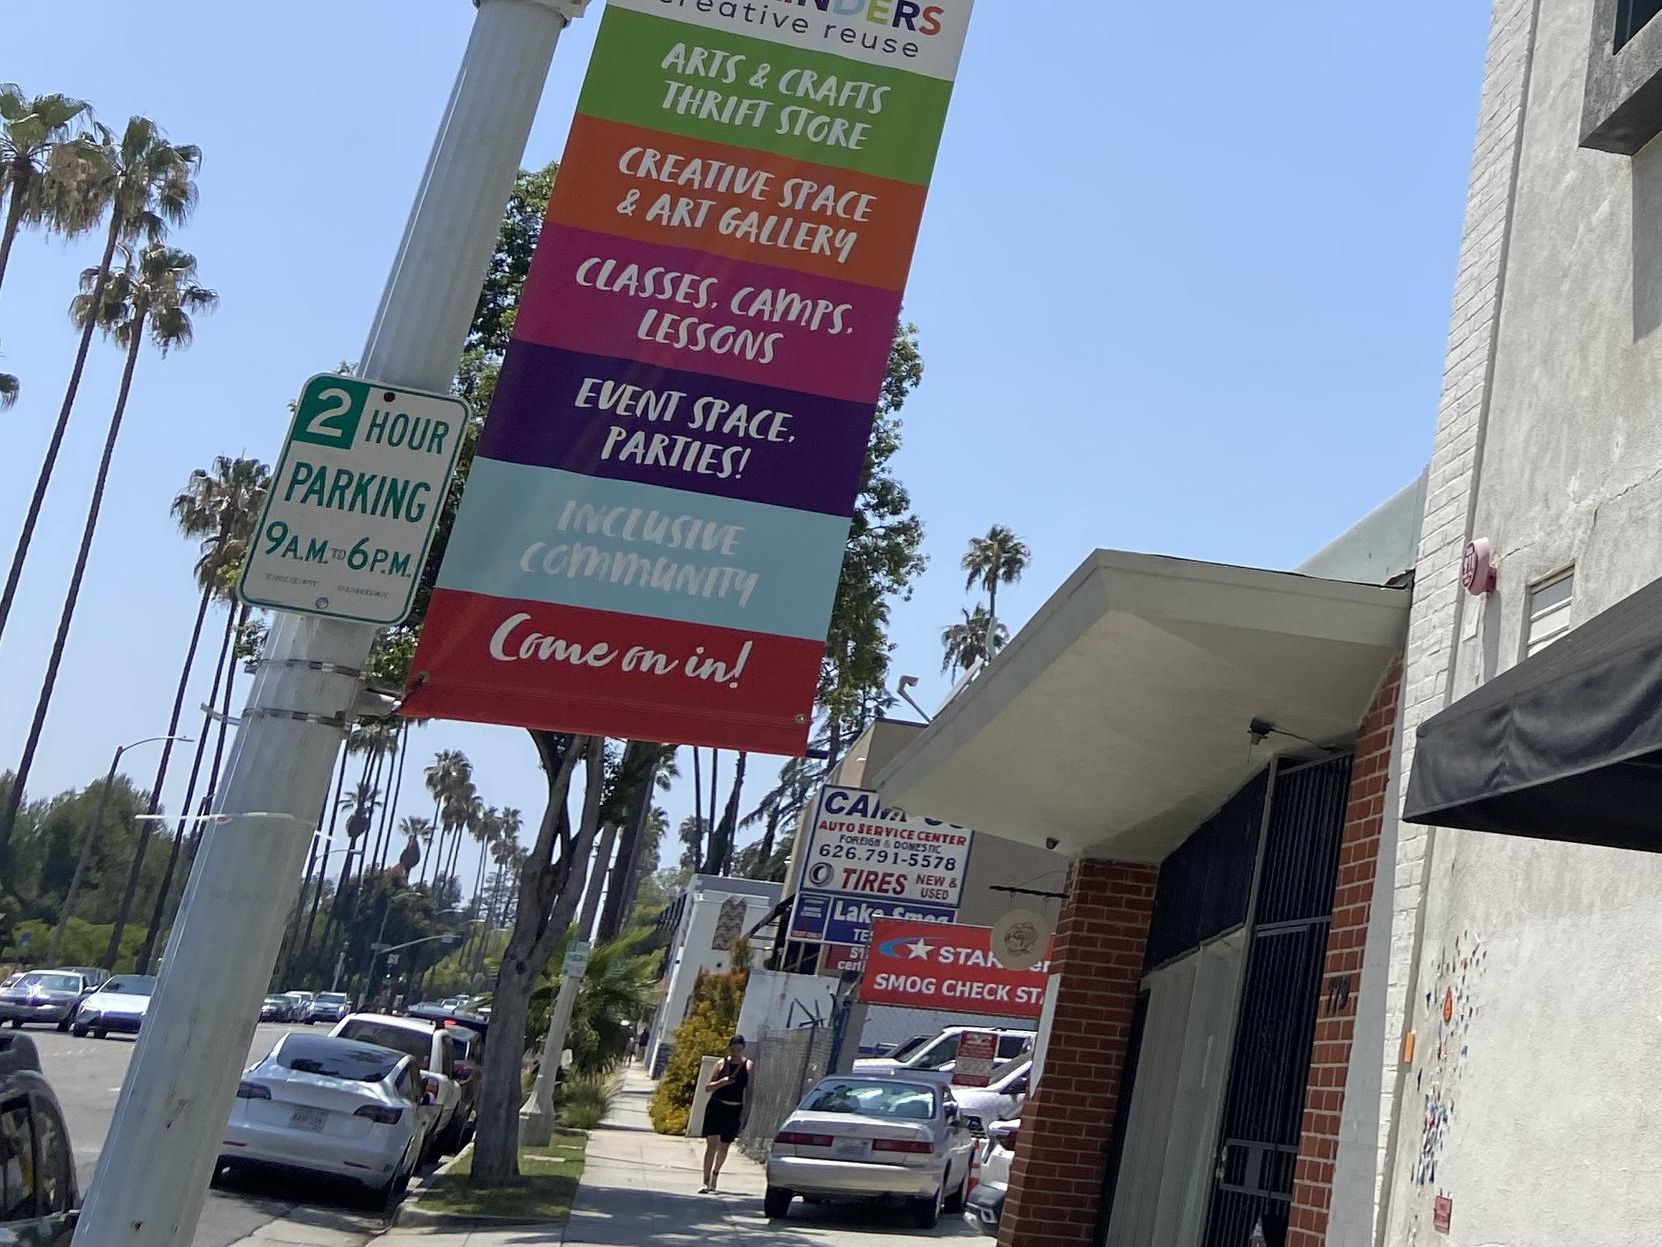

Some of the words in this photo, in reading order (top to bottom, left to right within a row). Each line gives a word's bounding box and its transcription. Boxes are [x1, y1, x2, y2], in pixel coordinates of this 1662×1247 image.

[824, 24, 919, 57] reuse
[661, 43, 745, 83] ARTS
[749, 63, 770, 89] &
[779, 69, 890, 114] CRAFTS
[662, 80, 774, 127] THRIFT
[775, 106, 872, 149] STORE
[618, 147, 775, 200] CREATIVE
[778, 178, 878, 222] SPACE
[617, 189, 641, 216] &
[646, 193, 716, 227] ART
[719, 208, 857, 263] GALLERY
[576, 258, 718, 310] CLASSES,
[730, 287, 853, 335] CAMPS,
[637, 309, 784, 364] LESSONS
[305, 387, 352, 437] 2
[365, 410, 449, 455] HOUR
[574, 378, 687, 421] EVENT
[688, 397, 794, 443] SPACE,
[601, 426, 751, 479] PARTIES!
[285, 461, 431, 523] PARKING
[557, 500, 745, 555] INCLUSIVE
[519, 542, 759, 608] COMMUNITY
[490, 613, 618, 667] Come
[621, 646, 679, 675] on
[685, 640, 753, 689] in!
[818, 820, 855, 833] AUTO
[857, 823, 915, 841] SERVICE
[917, 831, 967, 846] CENTER
[819, 843, 957, 871] 626.791-5578
[839, 834, 881, 847] FOREIGN
[893, 840, 942, 854] DOMESTIC
[841, 867, 908, 895] TIRES
[916, 874, 946, 887] NEW
[948, 877, 957, 888] &
[921, 887, 949, 900] USED
[874, 973, 937, 995] SMOG
[942, 979, 1011, 1002] CHECK
